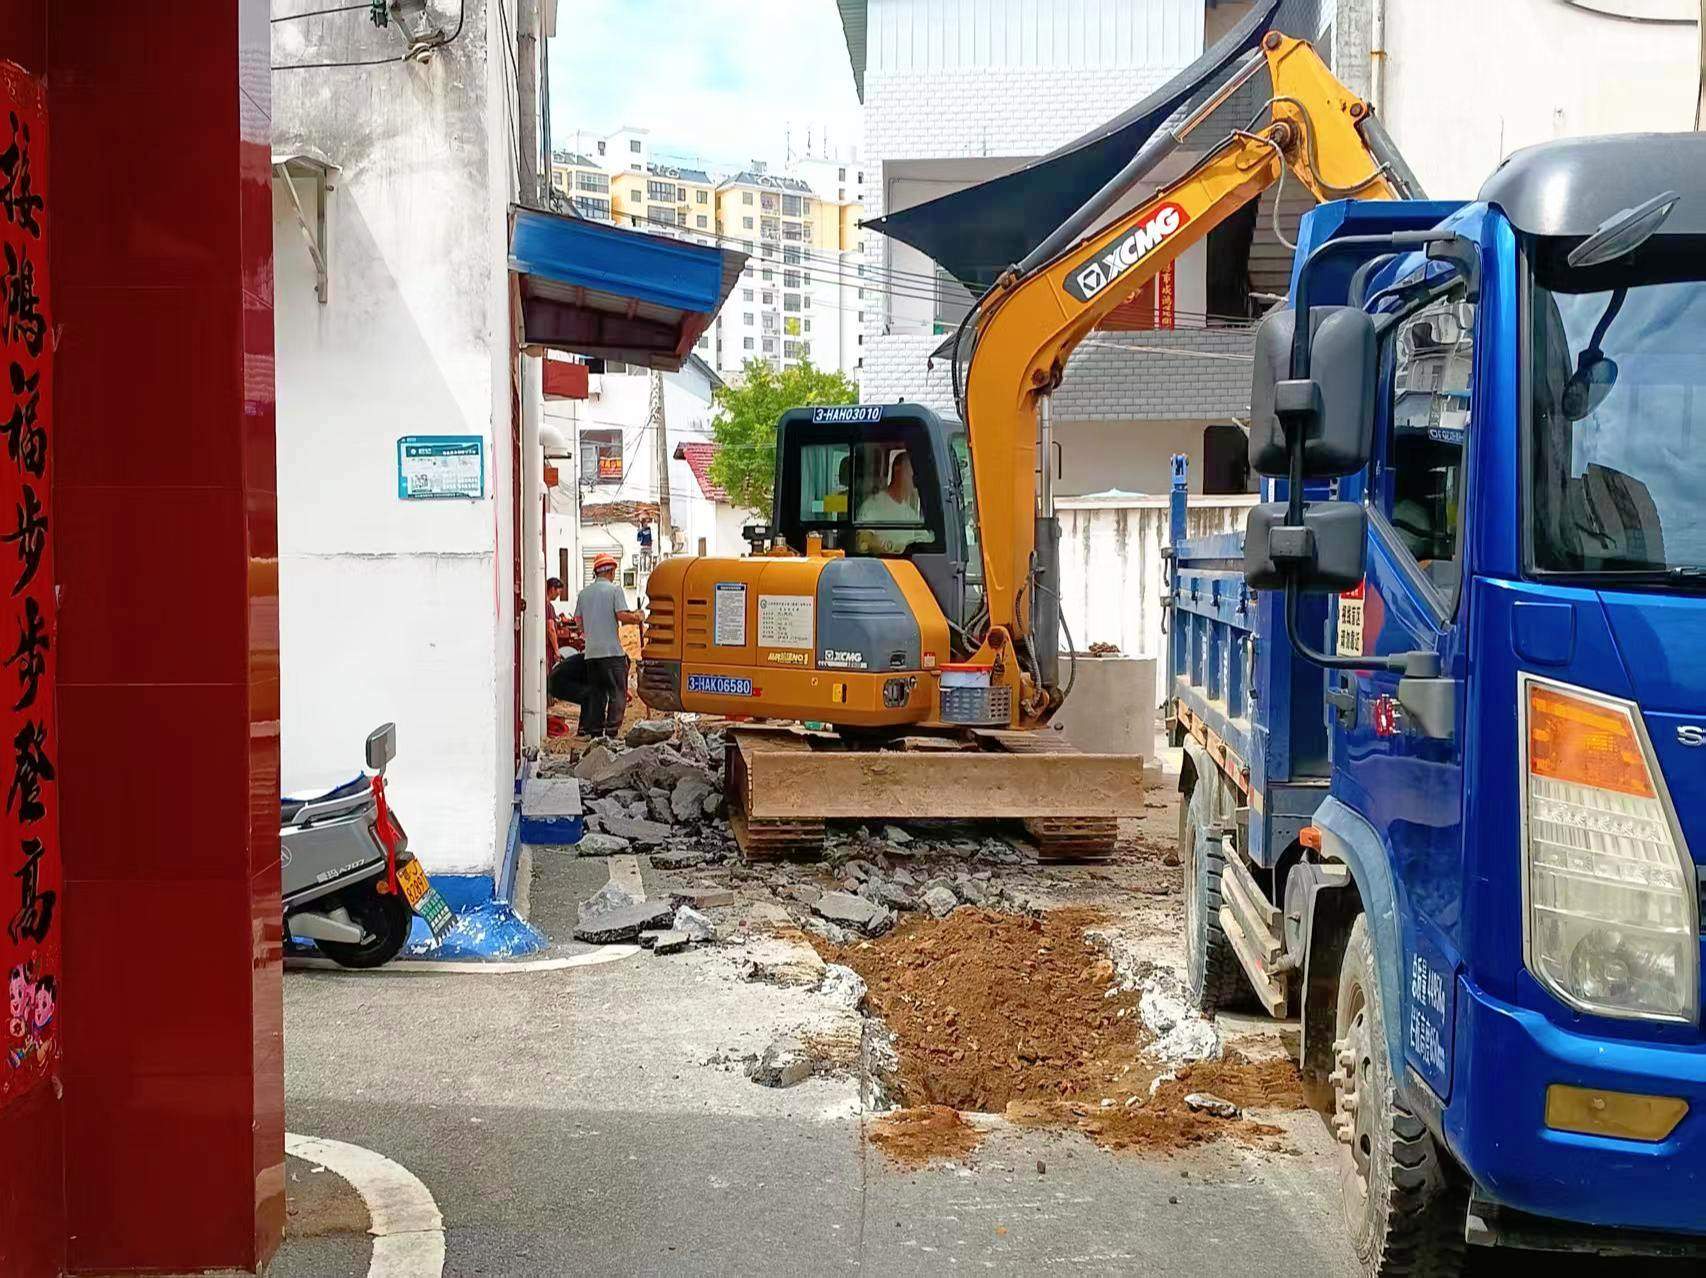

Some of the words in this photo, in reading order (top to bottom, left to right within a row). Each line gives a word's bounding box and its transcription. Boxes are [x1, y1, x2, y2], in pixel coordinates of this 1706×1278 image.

[1102, 206, 1180, 282] XCMG
[816, 407, 879, 421] 3-HAH03010
[834, 651, 862, 662] XCMG
[689, 677, 750, 693] 3-HAK06580
